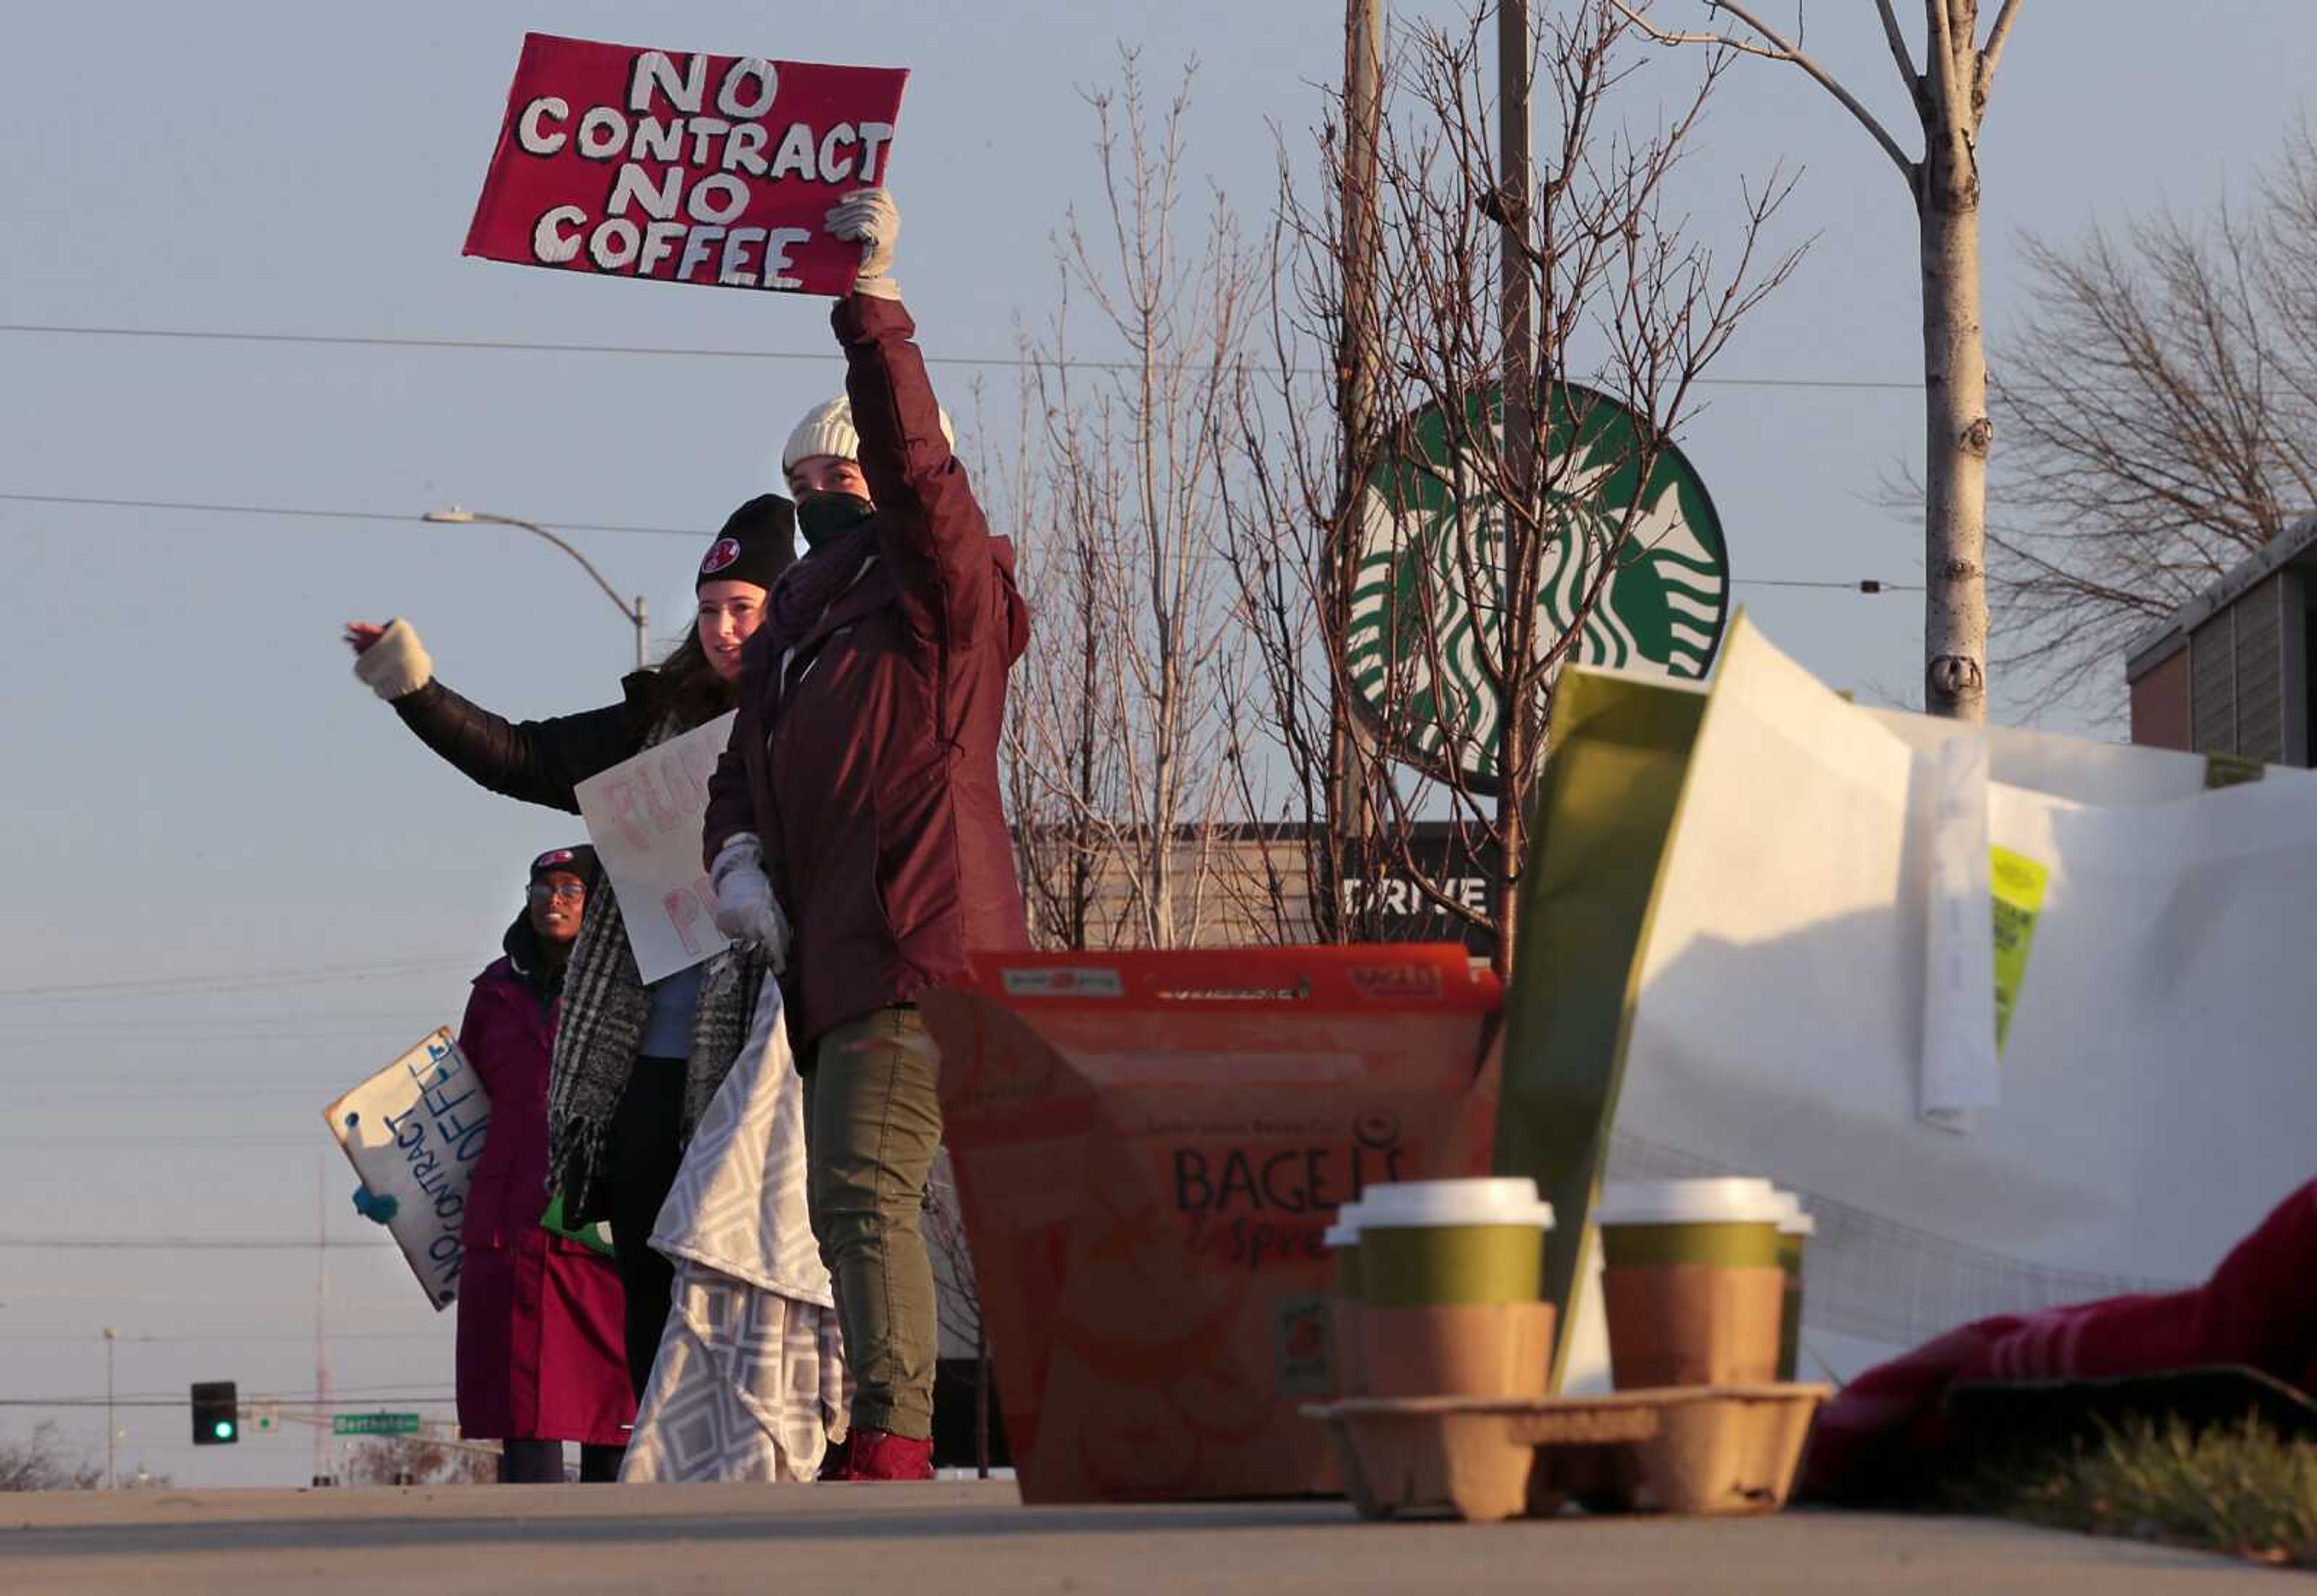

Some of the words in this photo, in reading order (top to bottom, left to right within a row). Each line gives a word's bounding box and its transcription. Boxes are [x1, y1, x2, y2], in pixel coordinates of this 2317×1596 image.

[629, 51, 779, 119] NO
[519, 97, 894, 183] CONTRACT
[607, 163, 751, 224] NO
[535, 205, 812, 288] COFFEE
[408, 1038, 488, 1181] OFFEE
